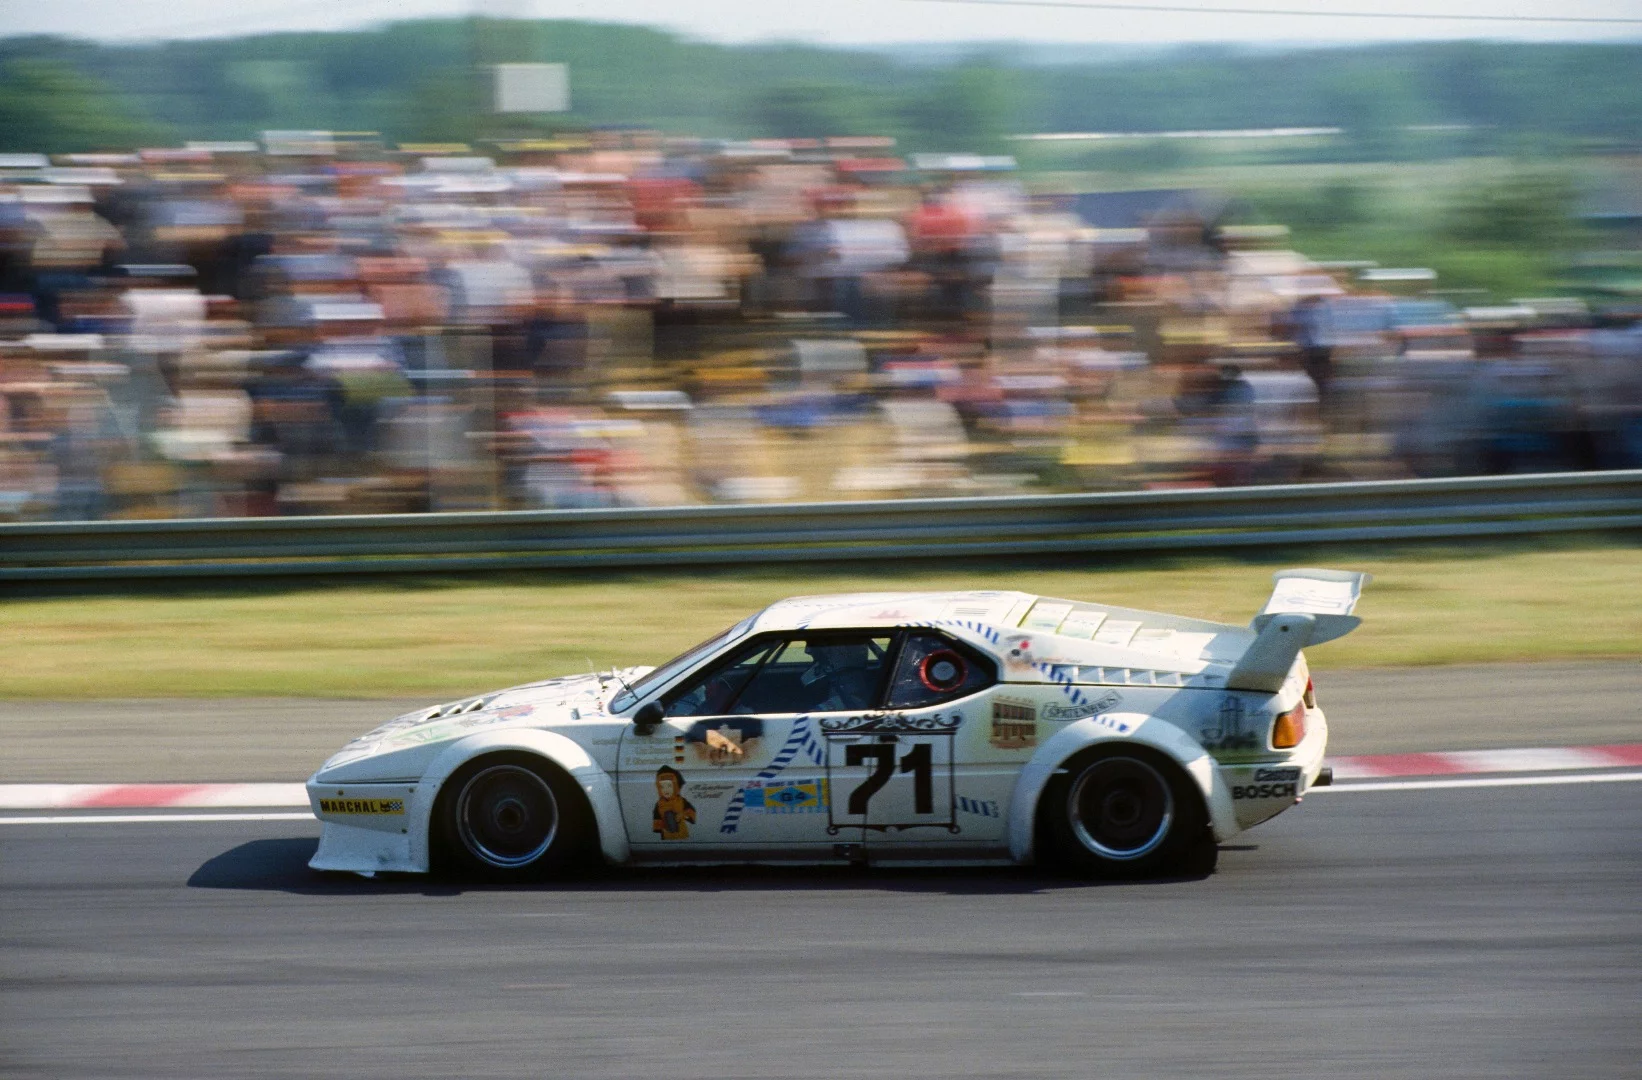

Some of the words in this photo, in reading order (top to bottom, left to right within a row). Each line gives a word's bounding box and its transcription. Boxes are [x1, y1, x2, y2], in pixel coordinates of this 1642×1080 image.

[746, 780, 762, 789] 24
[846, 743, 934, 814] 71
[1232, 783, 1298, 800] BOSCH
[320, 801, 379, 813] MARCHAL
